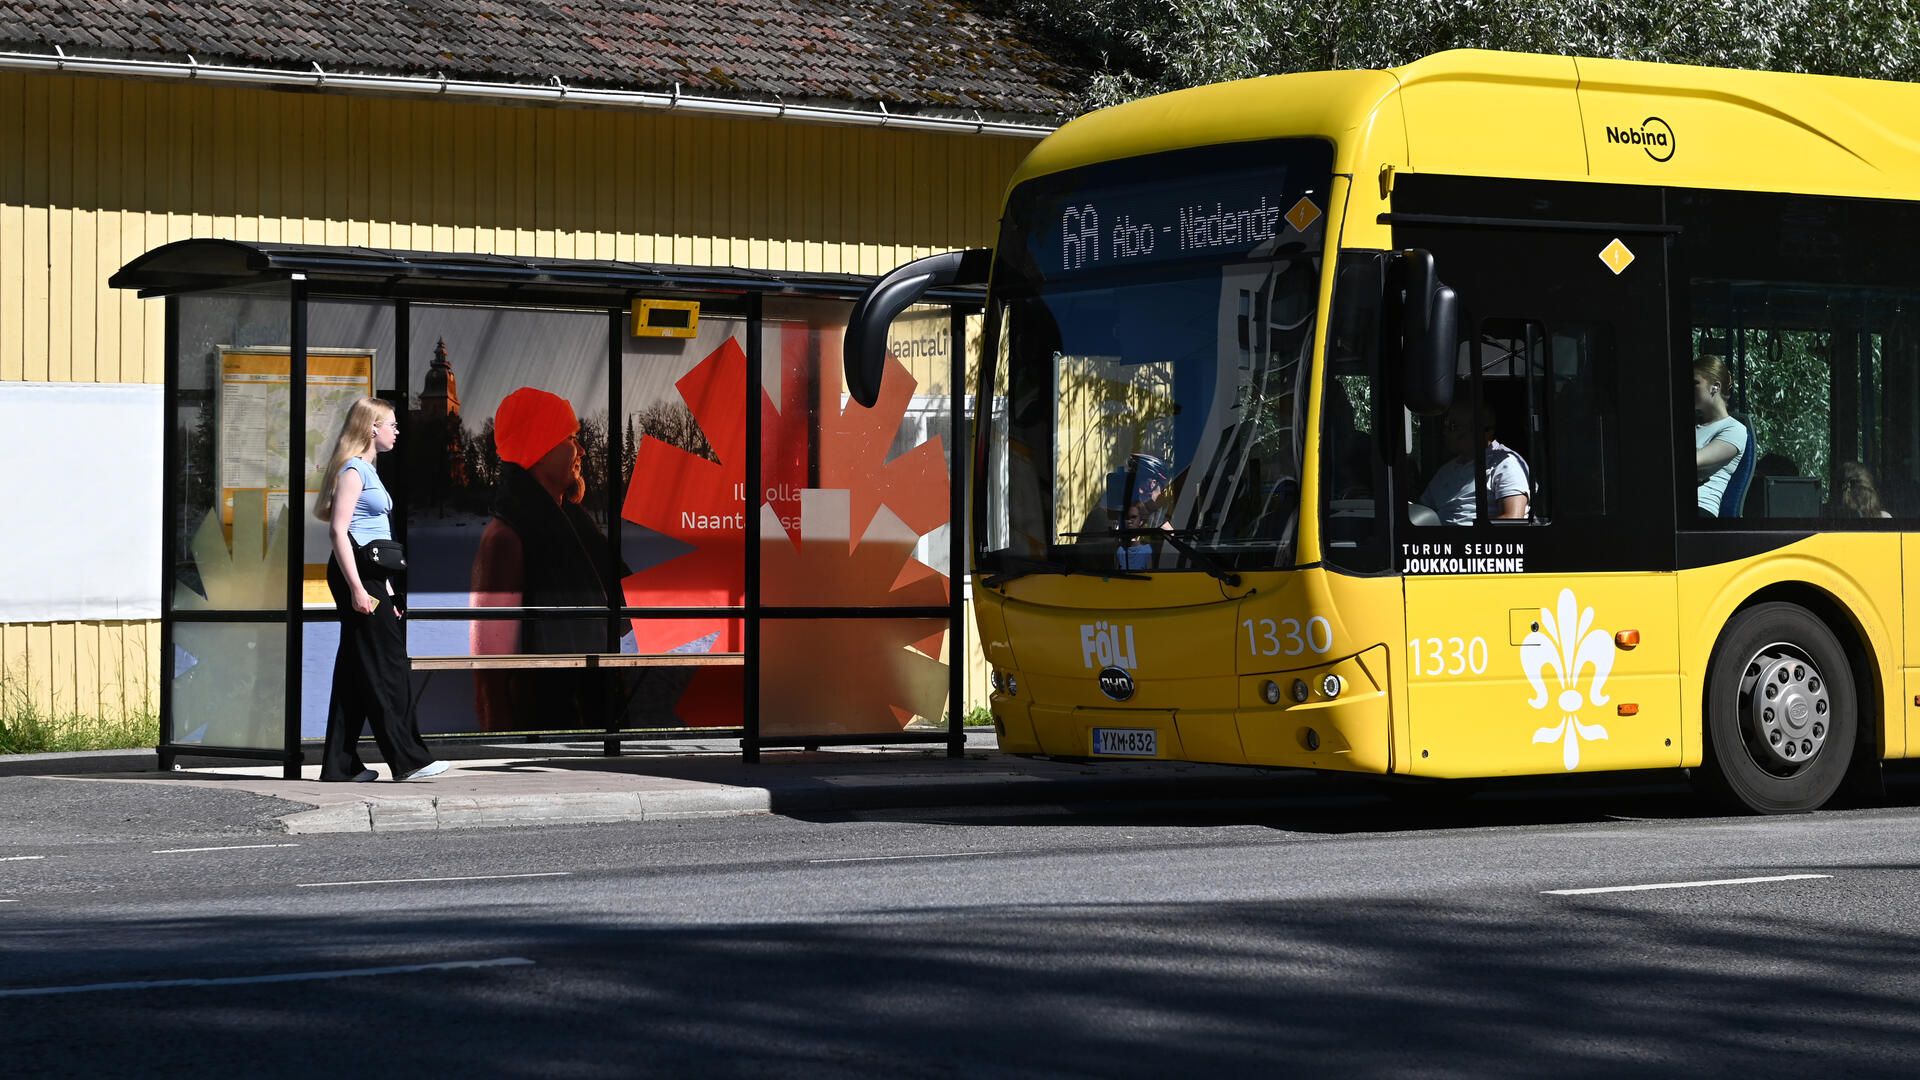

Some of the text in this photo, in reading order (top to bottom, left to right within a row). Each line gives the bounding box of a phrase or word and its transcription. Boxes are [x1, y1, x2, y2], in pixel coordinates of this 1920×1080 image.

[1606, 126, 1667, 146] Nobina
[1062, 204, 1099, 269] 6A
[1113, 215, 1154, 258] Åbo
[766, 483, 801, 501] olla
[1402, 543, 1524, 555] TURUN SEUDUN
[1402, 558, 1524, 573] JOUKKOLIIKENNE
[1080, 621, 1137, 669] FÖLI
[1243, 616, 1332, 656] 1330
[1409, 636, 1488, 676] 1330
[1102, 732, 1153, 752] YXM-832
